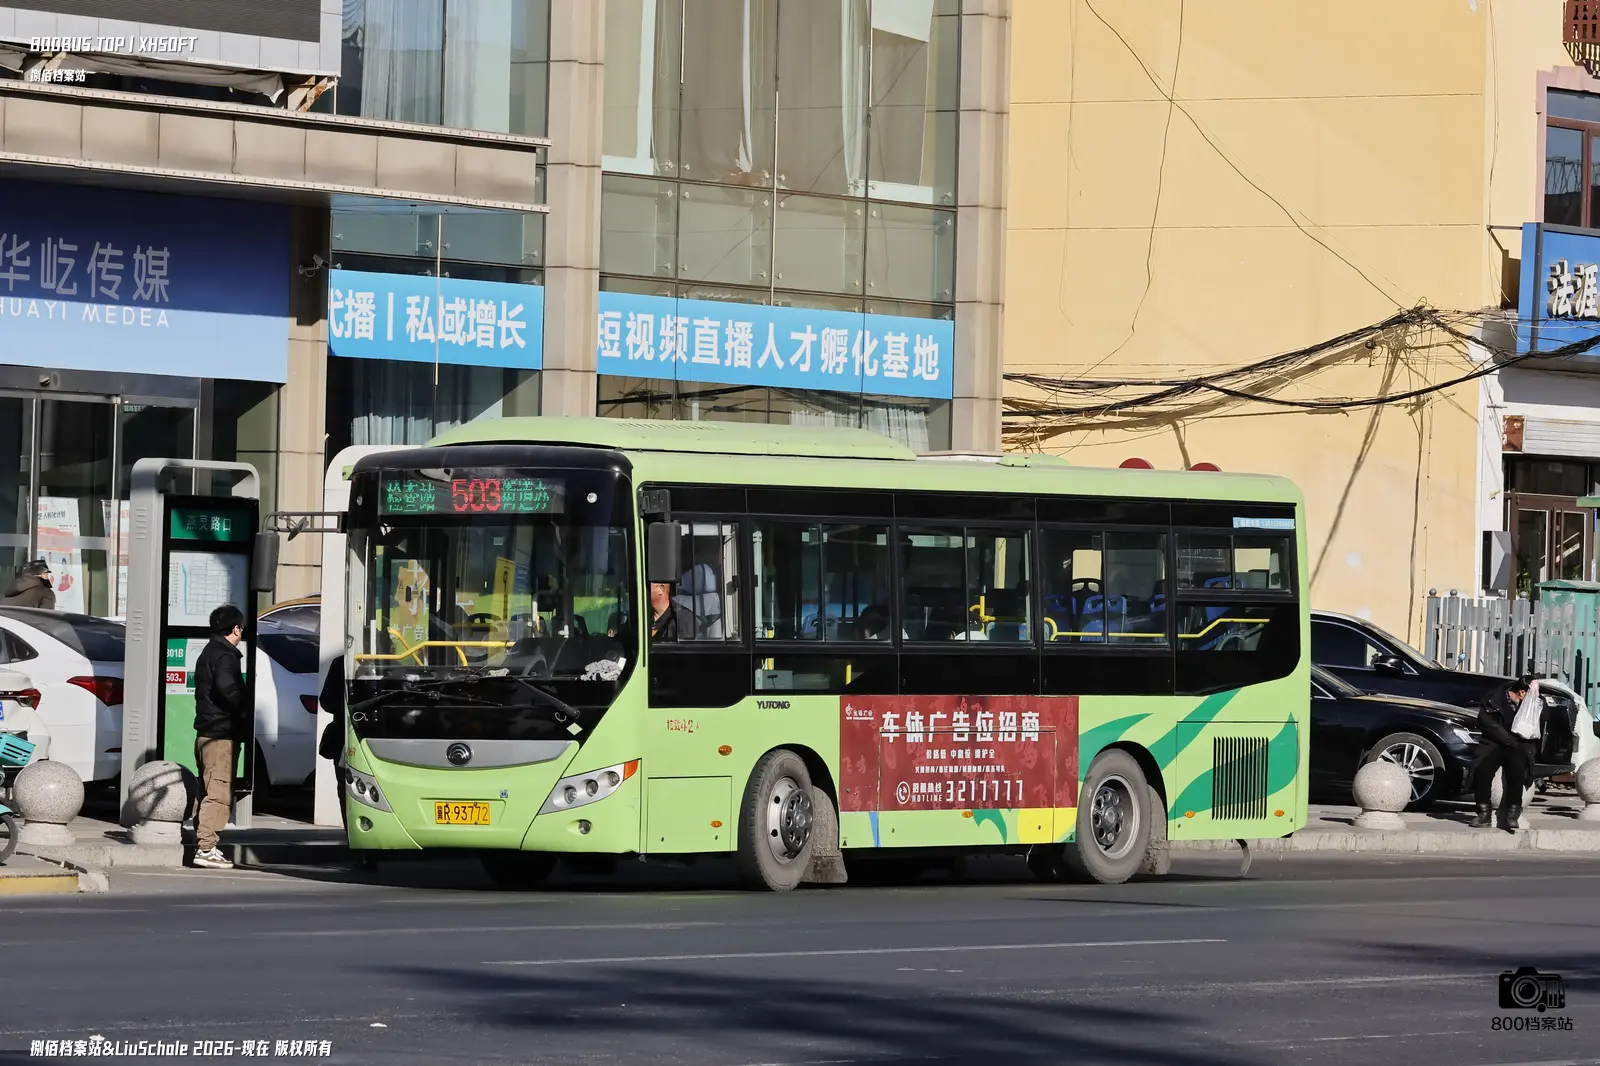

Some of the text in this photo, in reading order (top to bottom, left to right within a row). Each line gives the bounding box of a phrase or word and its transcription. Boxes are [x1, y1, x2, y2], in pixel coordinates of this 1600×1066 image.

[82, 306, 170, 328] MEDEA
[597, 311, 939, 382] 短视频直播人才孵化基地
[451, 478, 502, 512] 503
[756, 701, 791, 709] YUTONG
[881, 711, 1040, 743] 车体广告位招商
[911, 794, 942, 803] HOTLINE
[946, 779, 1023, 802] 3217777
